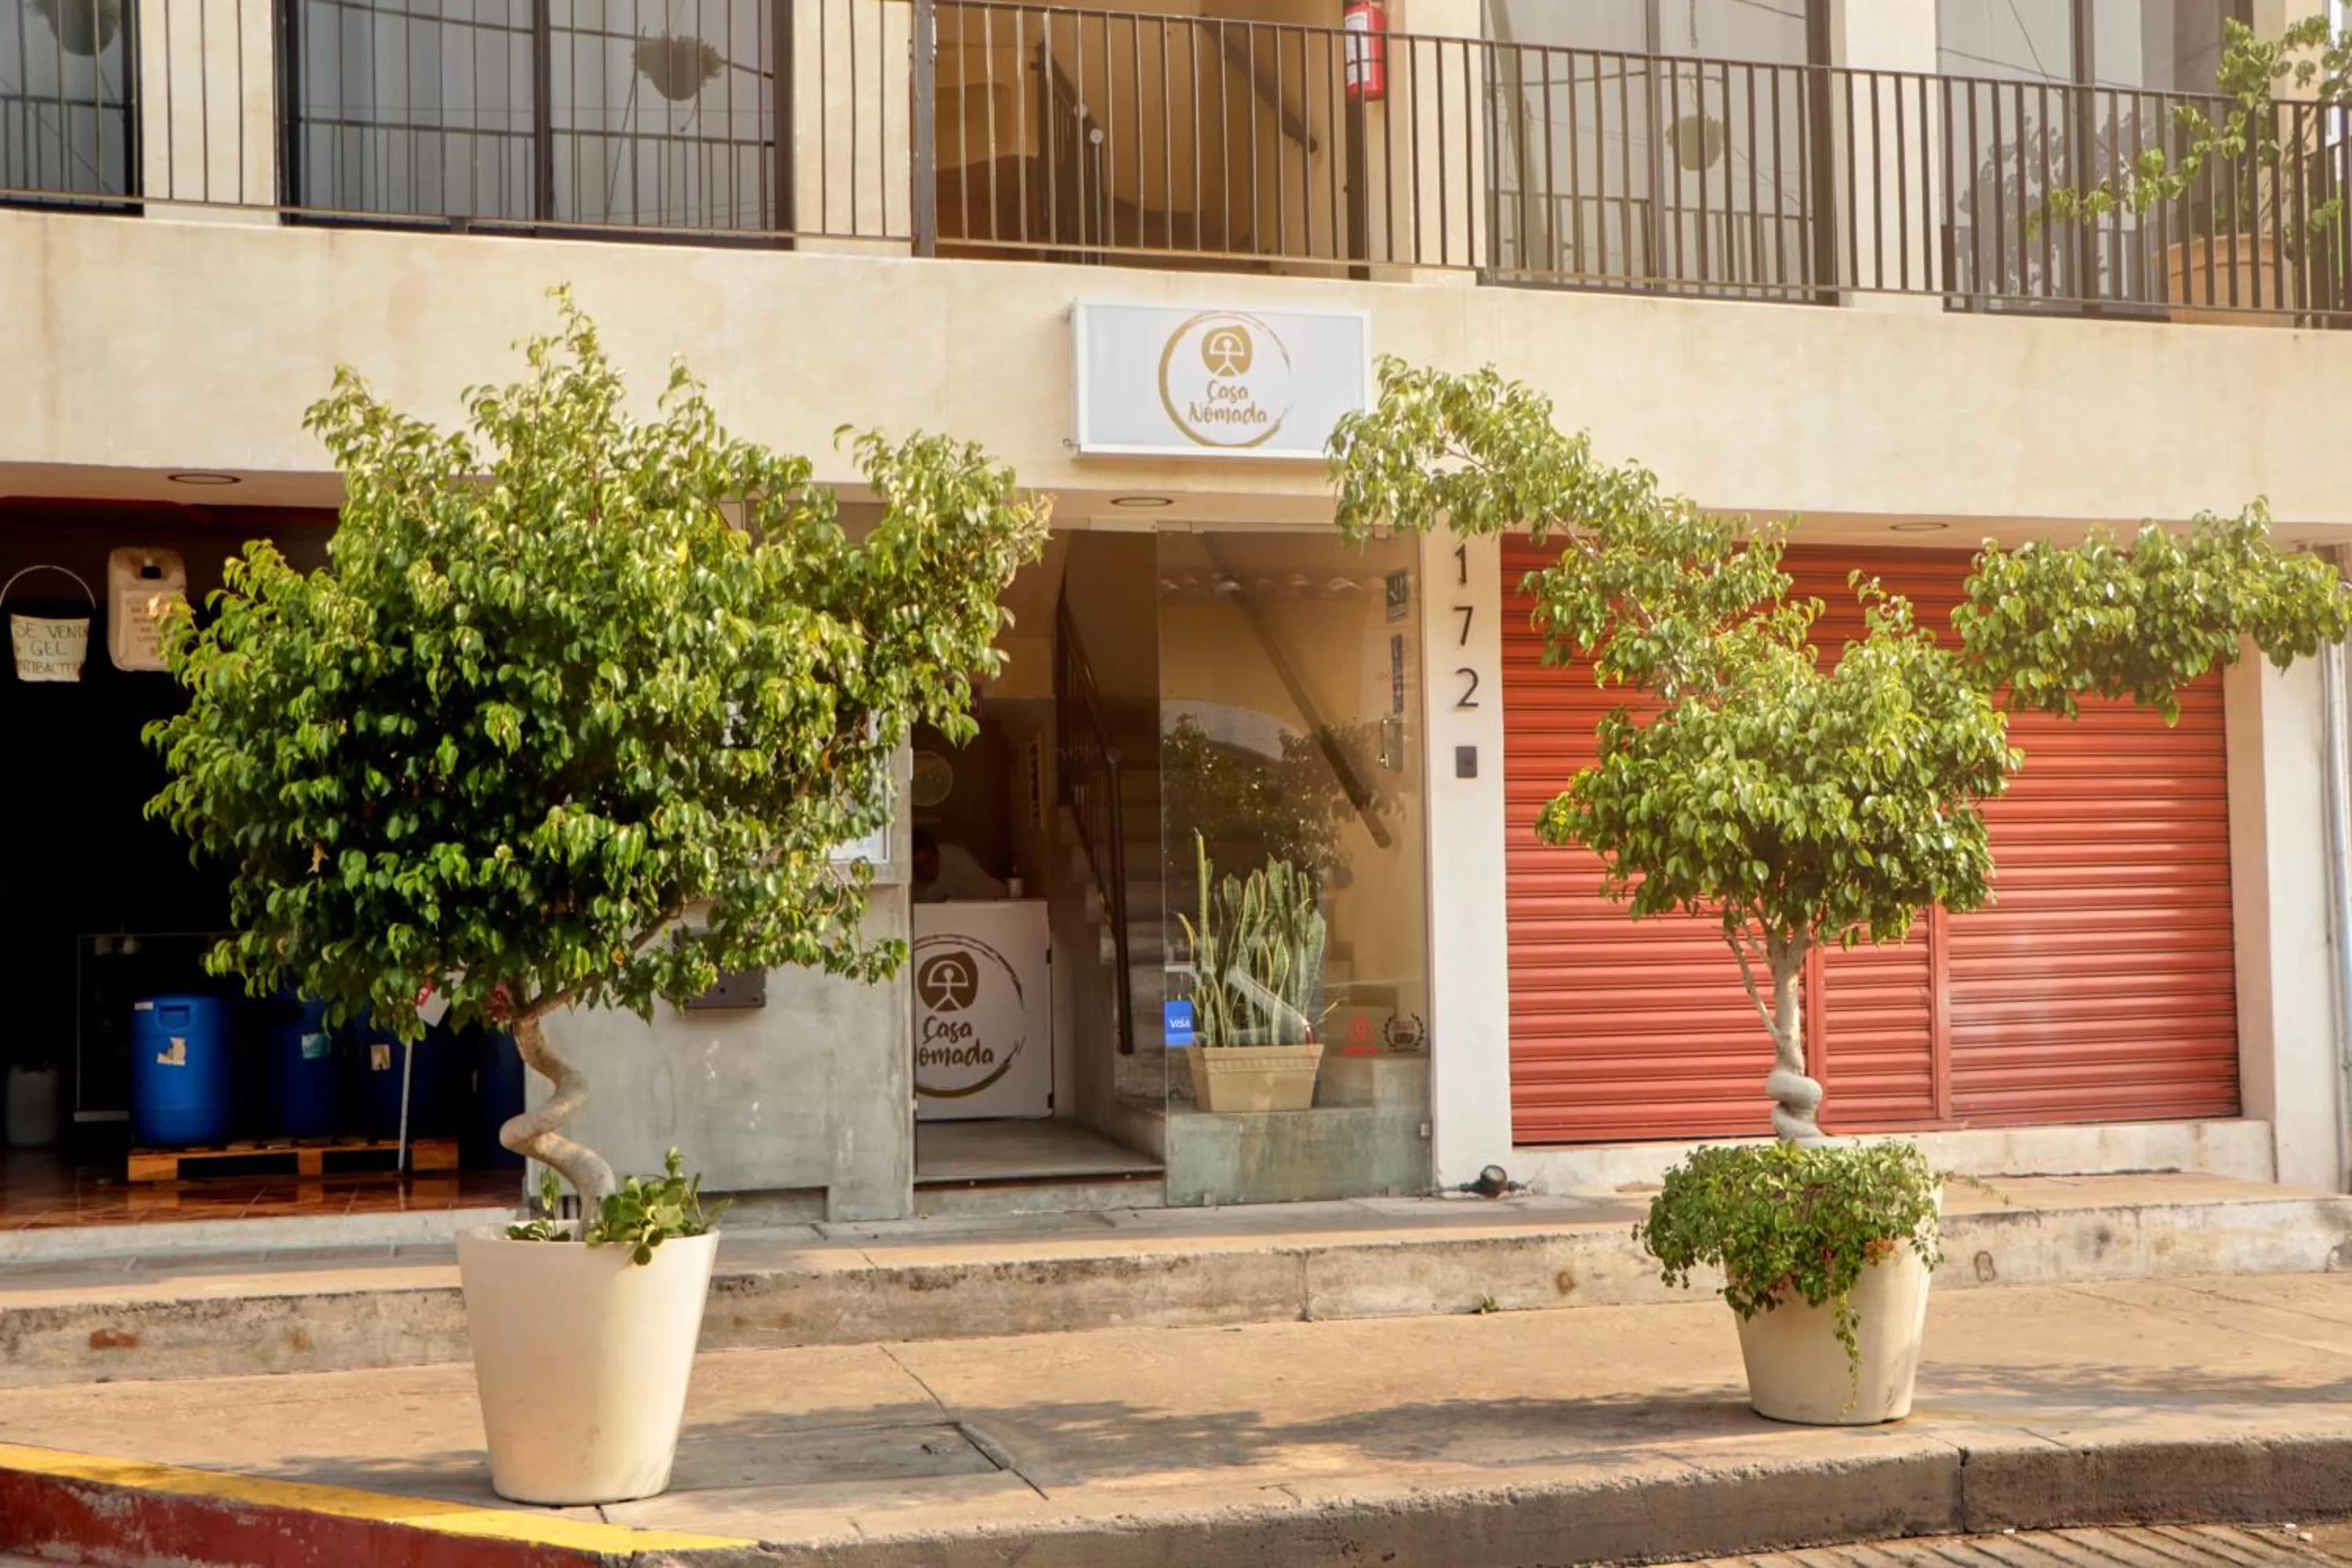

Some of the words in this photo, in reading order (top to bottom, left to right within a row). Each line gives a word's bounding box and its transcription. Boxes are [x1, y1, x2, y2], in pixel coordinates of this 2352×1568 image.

[1207, 379, 1249, 404] Casa
[923, 1014, 973, 1045] Casa
[1169, 1018, 1191, 1029] VISA
